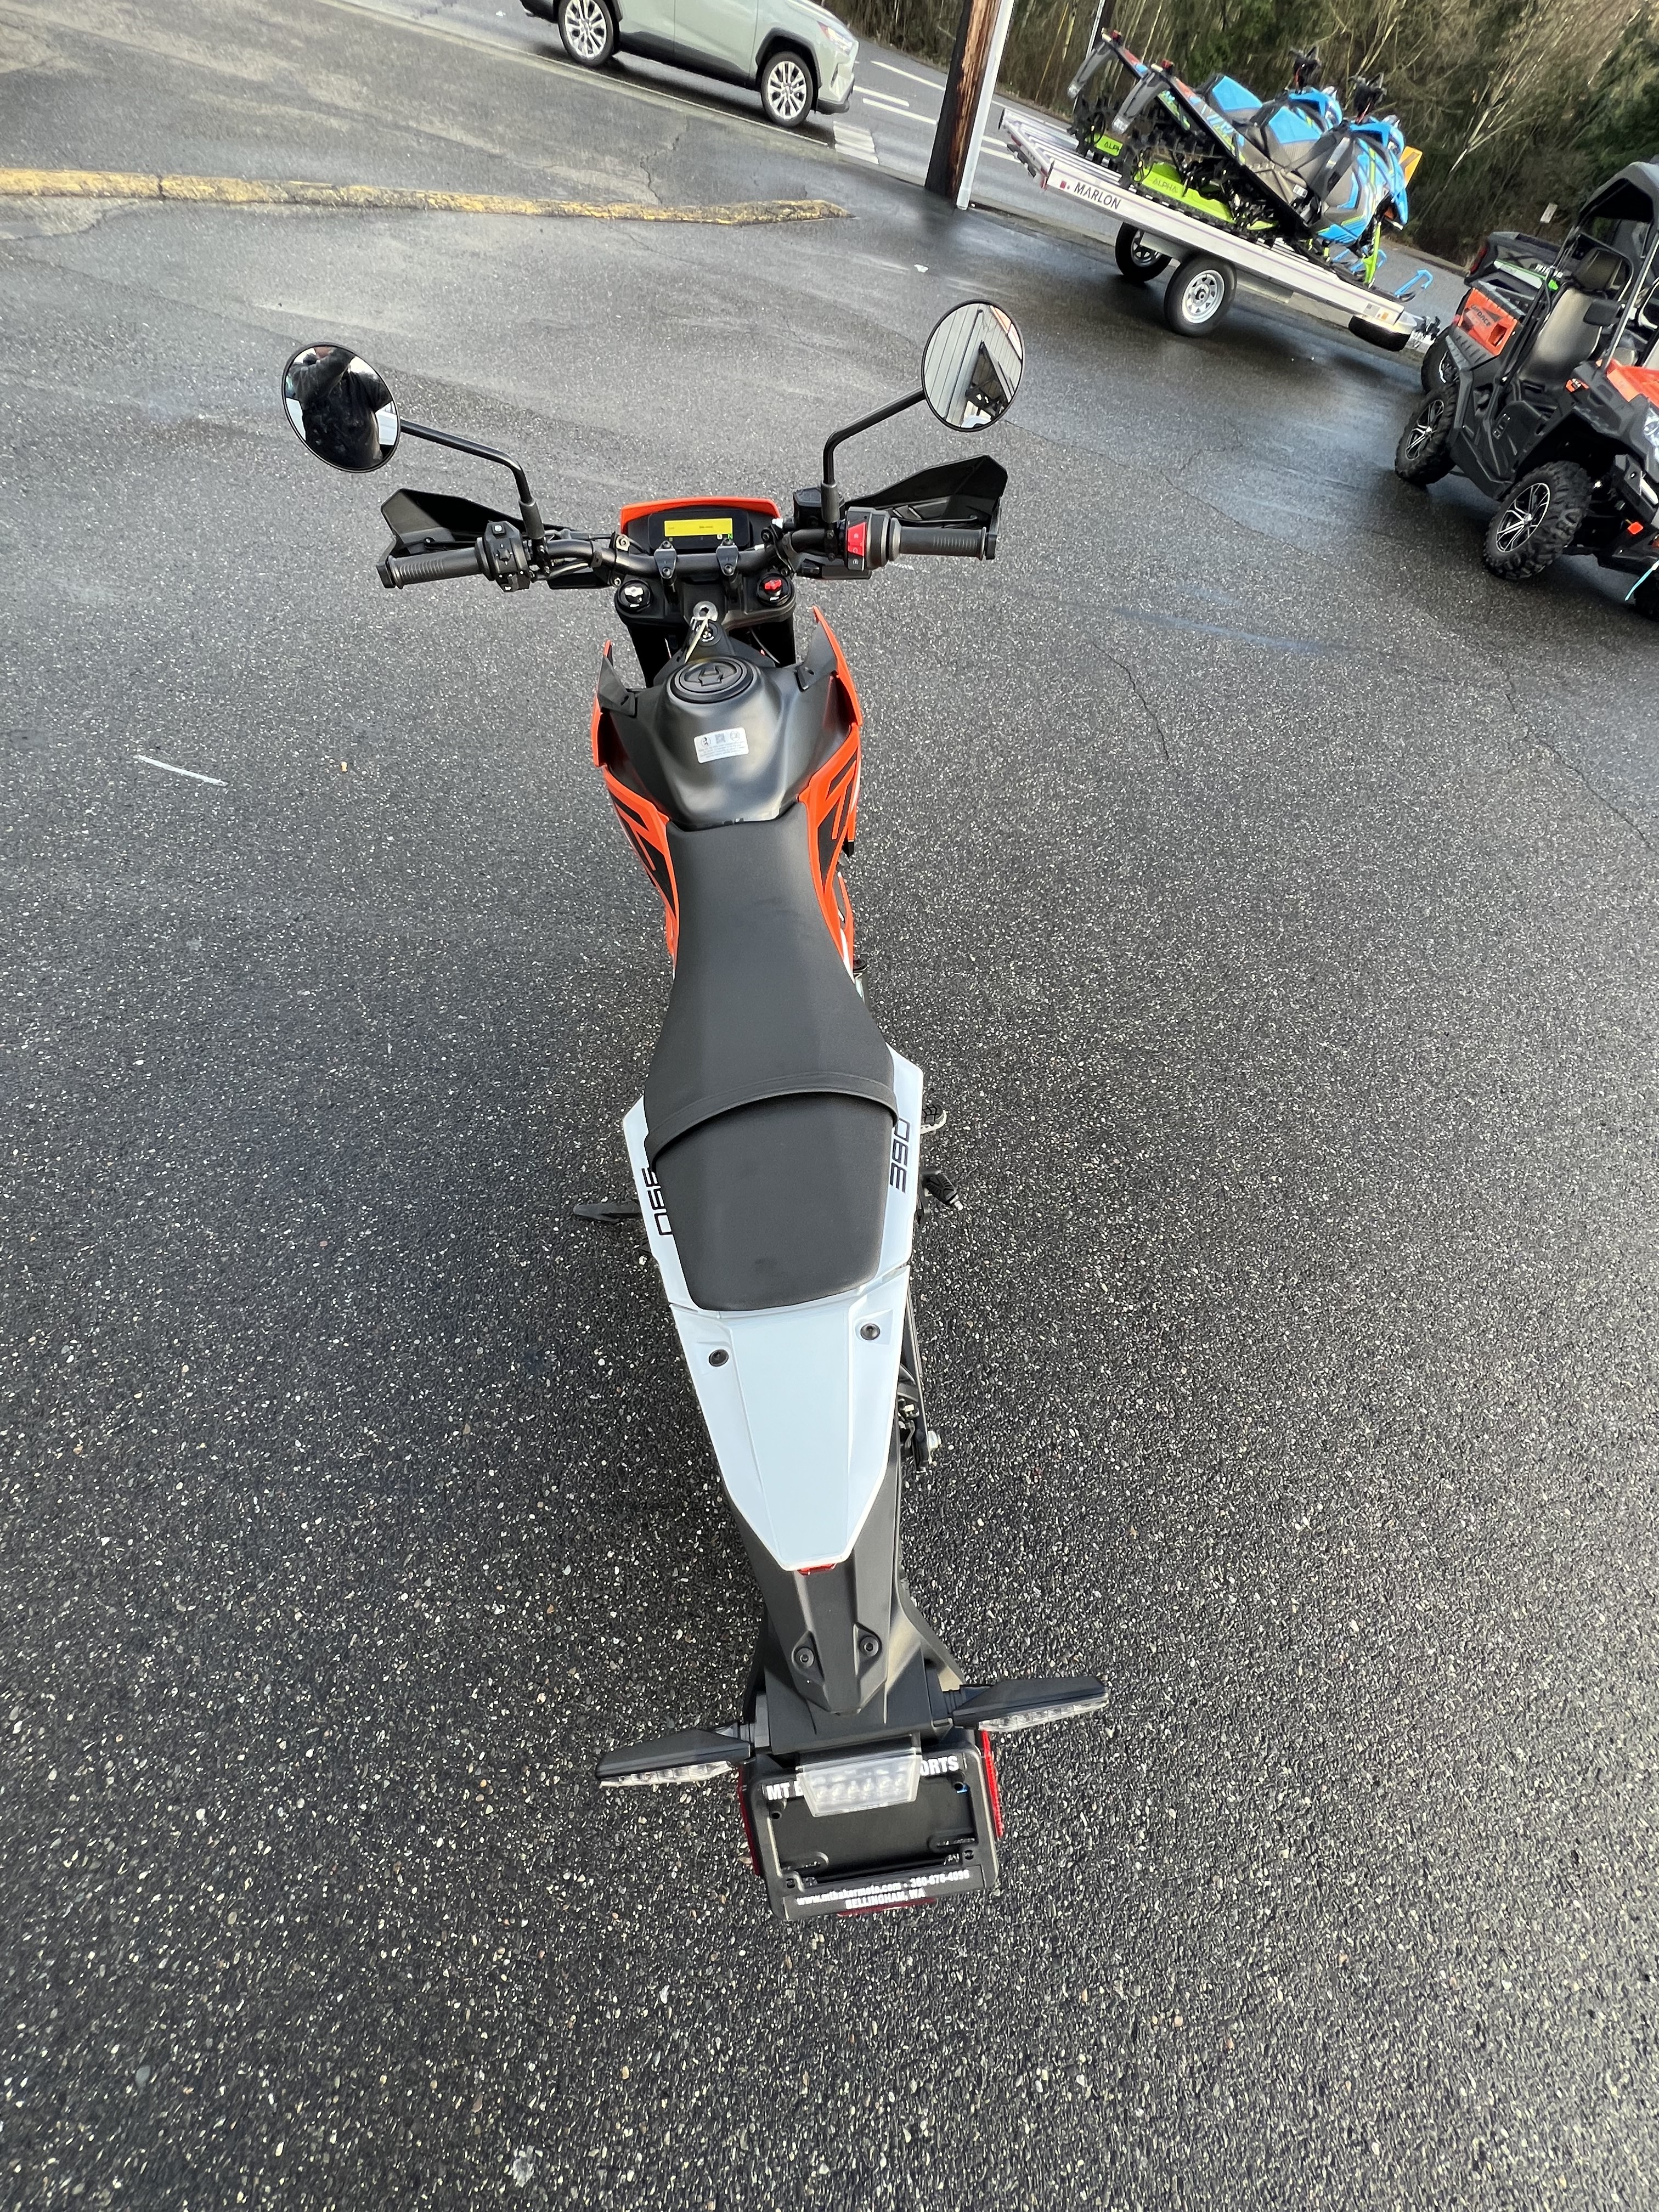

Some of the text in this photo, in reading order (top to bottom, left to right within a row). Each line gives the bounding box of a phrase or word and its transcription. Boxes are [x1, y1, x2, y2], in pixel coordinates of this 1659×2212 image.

[1074, 182, 1121, 210] MARLON
[1153, 178, 1178, 193] ALPHA
[889, 1117, 910, 1194] 390
[766, 1781, 790, 1801] MT
[845, 1887, 926, 1910] BELLINGHAM, WA
